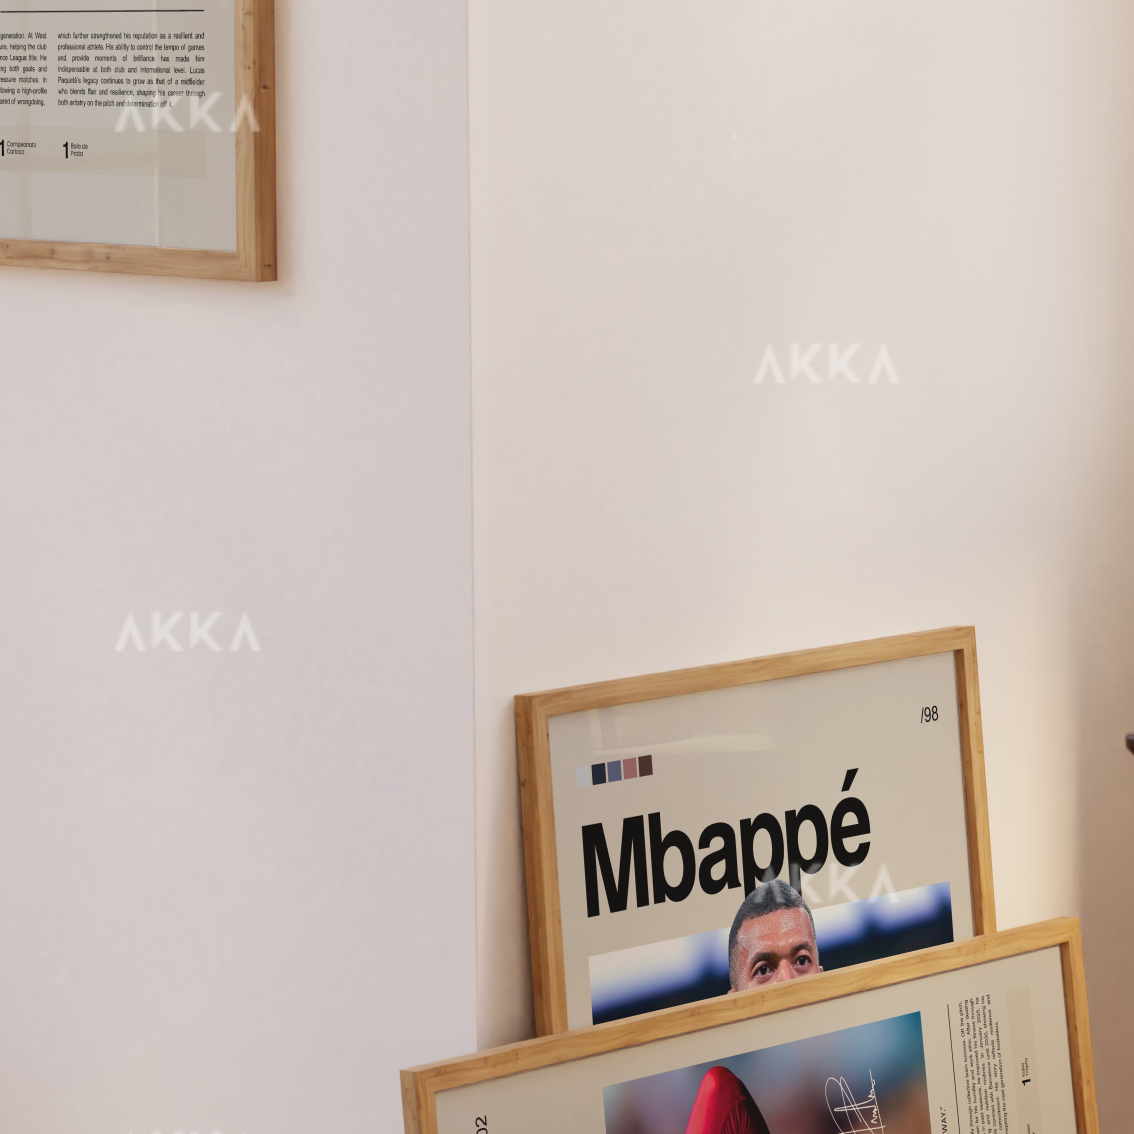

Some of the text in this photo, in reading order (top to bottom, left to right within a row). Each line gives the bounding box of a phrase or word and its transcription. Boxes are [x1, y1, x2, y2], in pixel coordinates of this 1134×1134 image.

[72, 32, 89, 40] further
[90, 33, 123, 41] strengthened
[123, 32, 132, 40] his
[132, 32, 159, 41] reputation
[173, 32, 193, 40] resilient
[194, 32, 205, 40] and
[57, 43, 87, 52] professional
[115, 44, 130, 52] ability
[163, 44, 180, 52] tempo
[187, 45, 205, 53] games
[71, 55, 90, 63] provide
[175, 55, 190, 63] made
[0, 140, 4, 156] 1
[7, 141, 37, 149] Campeonato
[63, 142, 68, 158] 1
[919, 704, 939, 724] /98
[580, 767, 872, 919] Mbappé
[1021, 1078, 1031, 1086] 1
